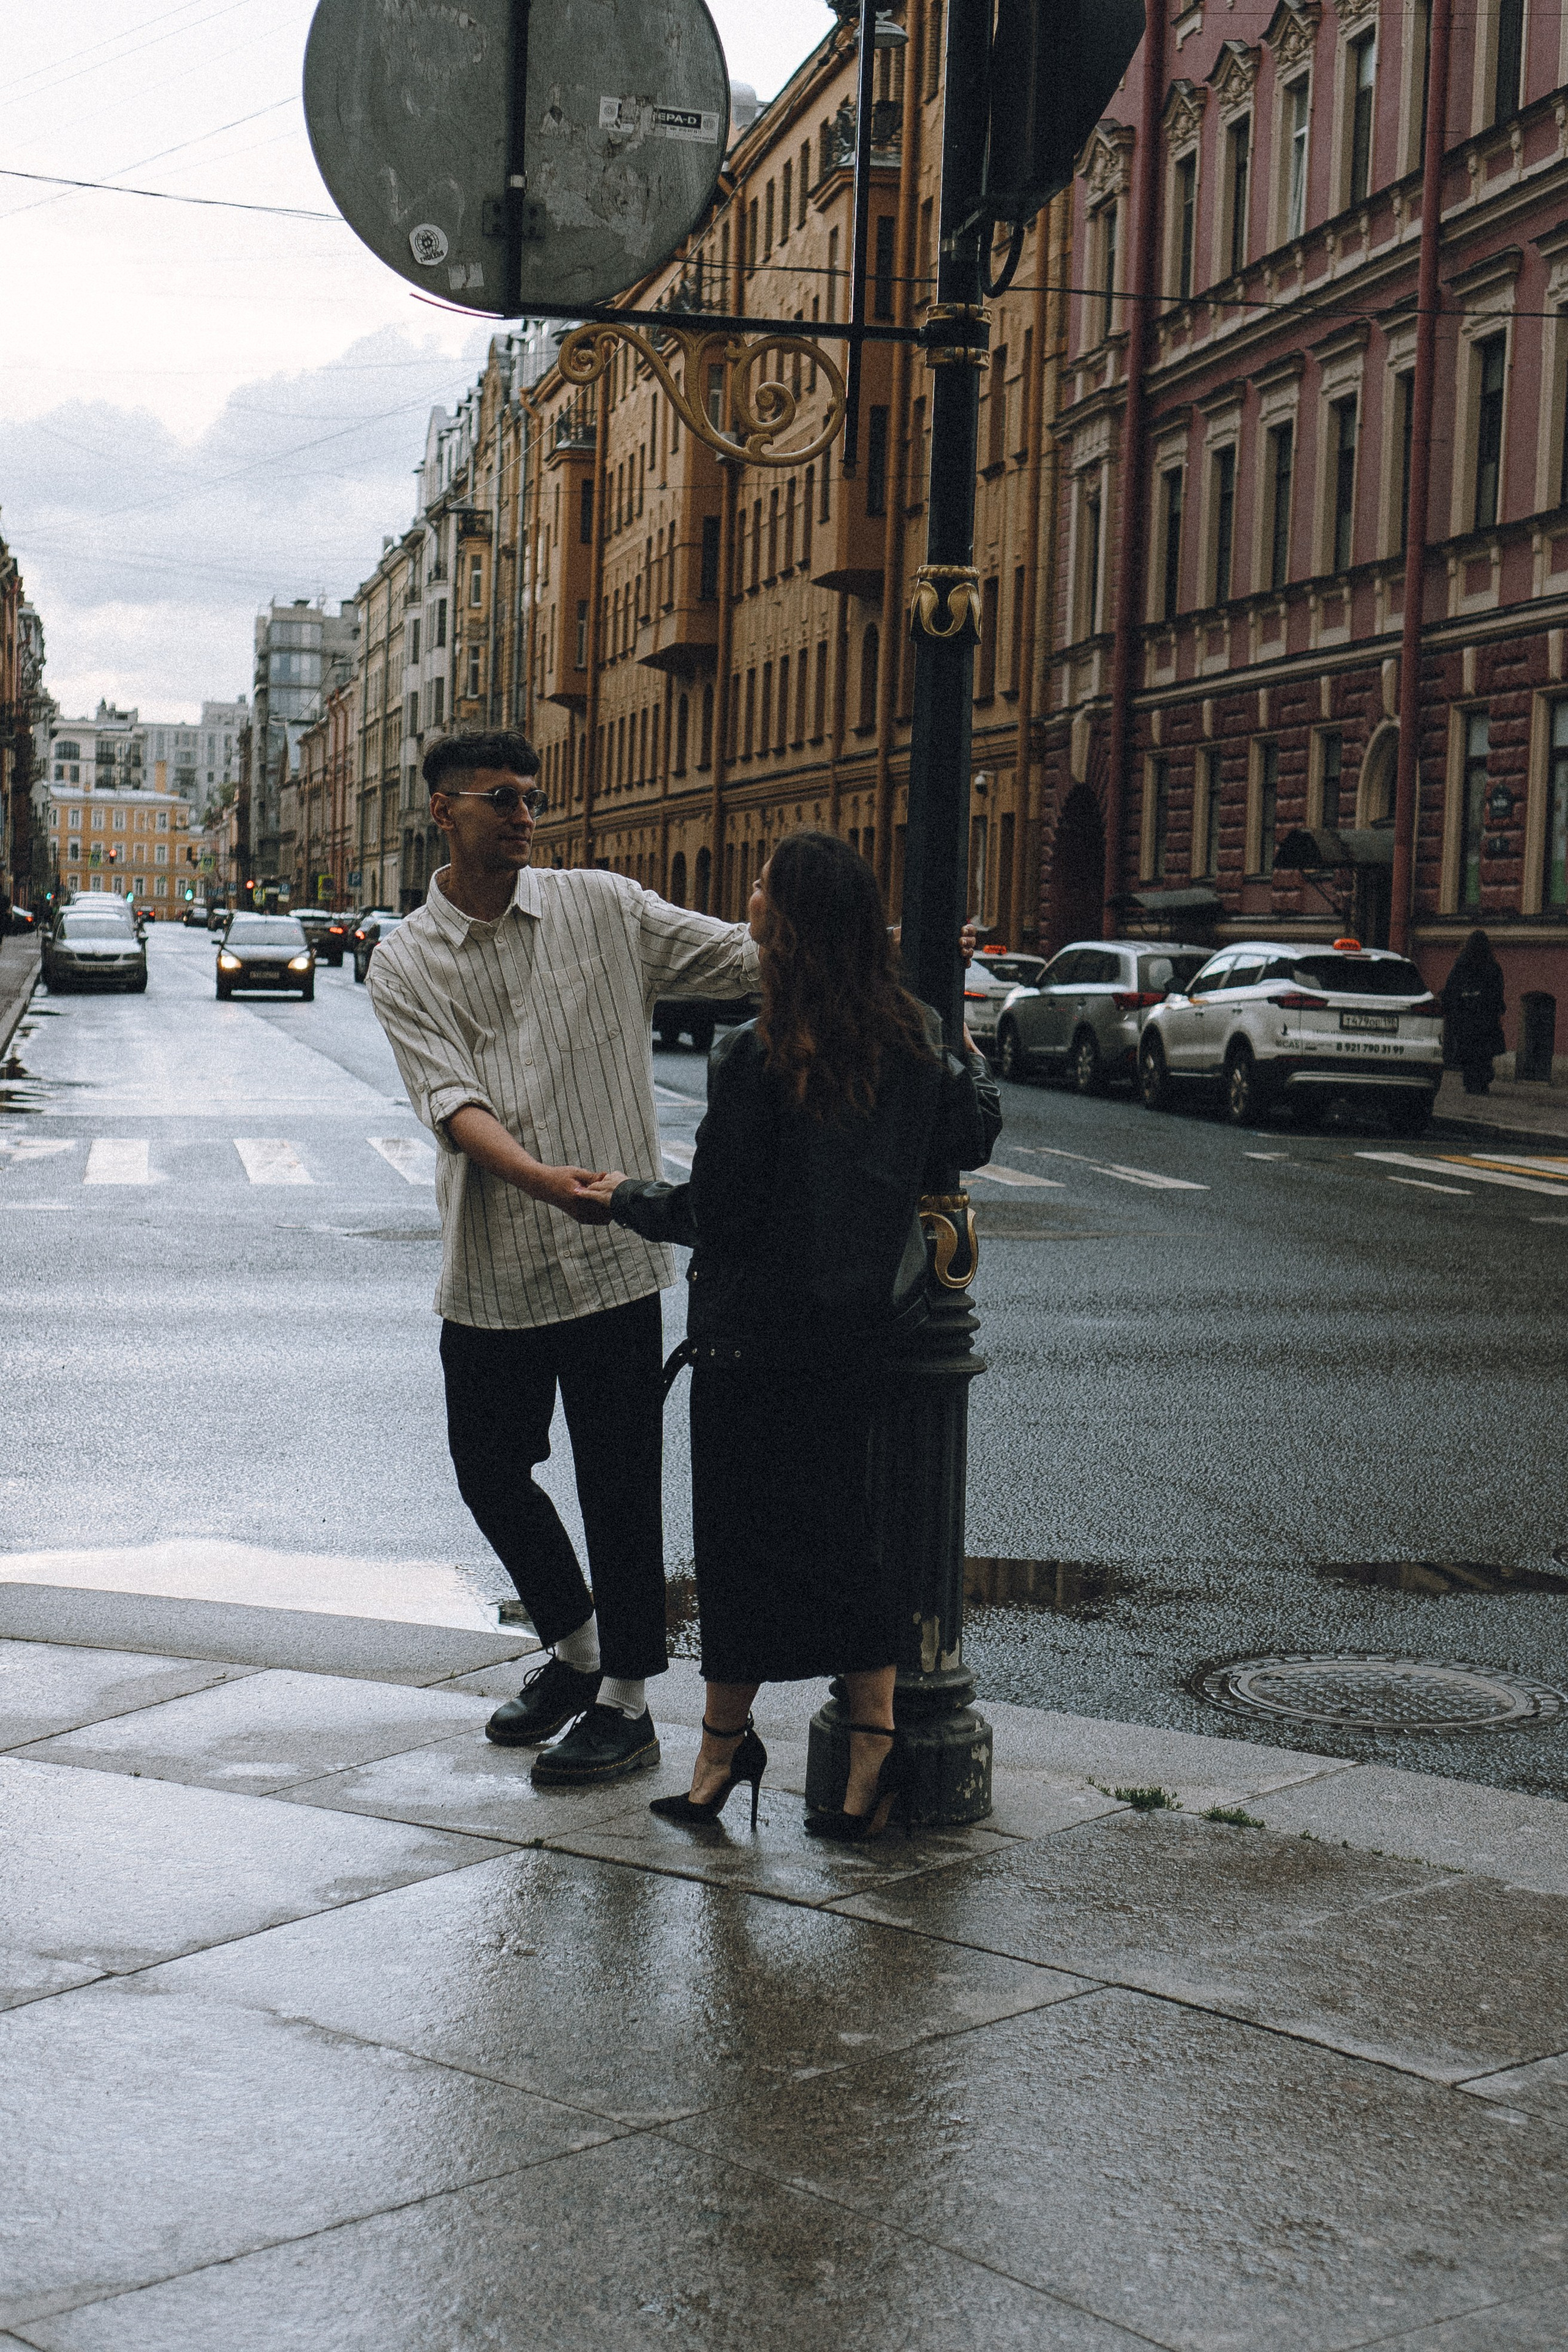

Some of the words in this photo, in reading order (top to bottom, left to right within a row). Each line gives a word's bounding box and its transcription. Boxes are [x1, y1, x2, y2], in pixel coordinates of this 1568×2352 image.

[654, 112, 697, 124] EPA-D
[420, 250, 444, 262] ENDLESS
[1345, 1043, 1360, 1052] 921
[1363, 1044, 1379, 1054] 790
[1382, 1044, 1391, 1054] 31
[1393, 1045, 1404, 1055] 99
